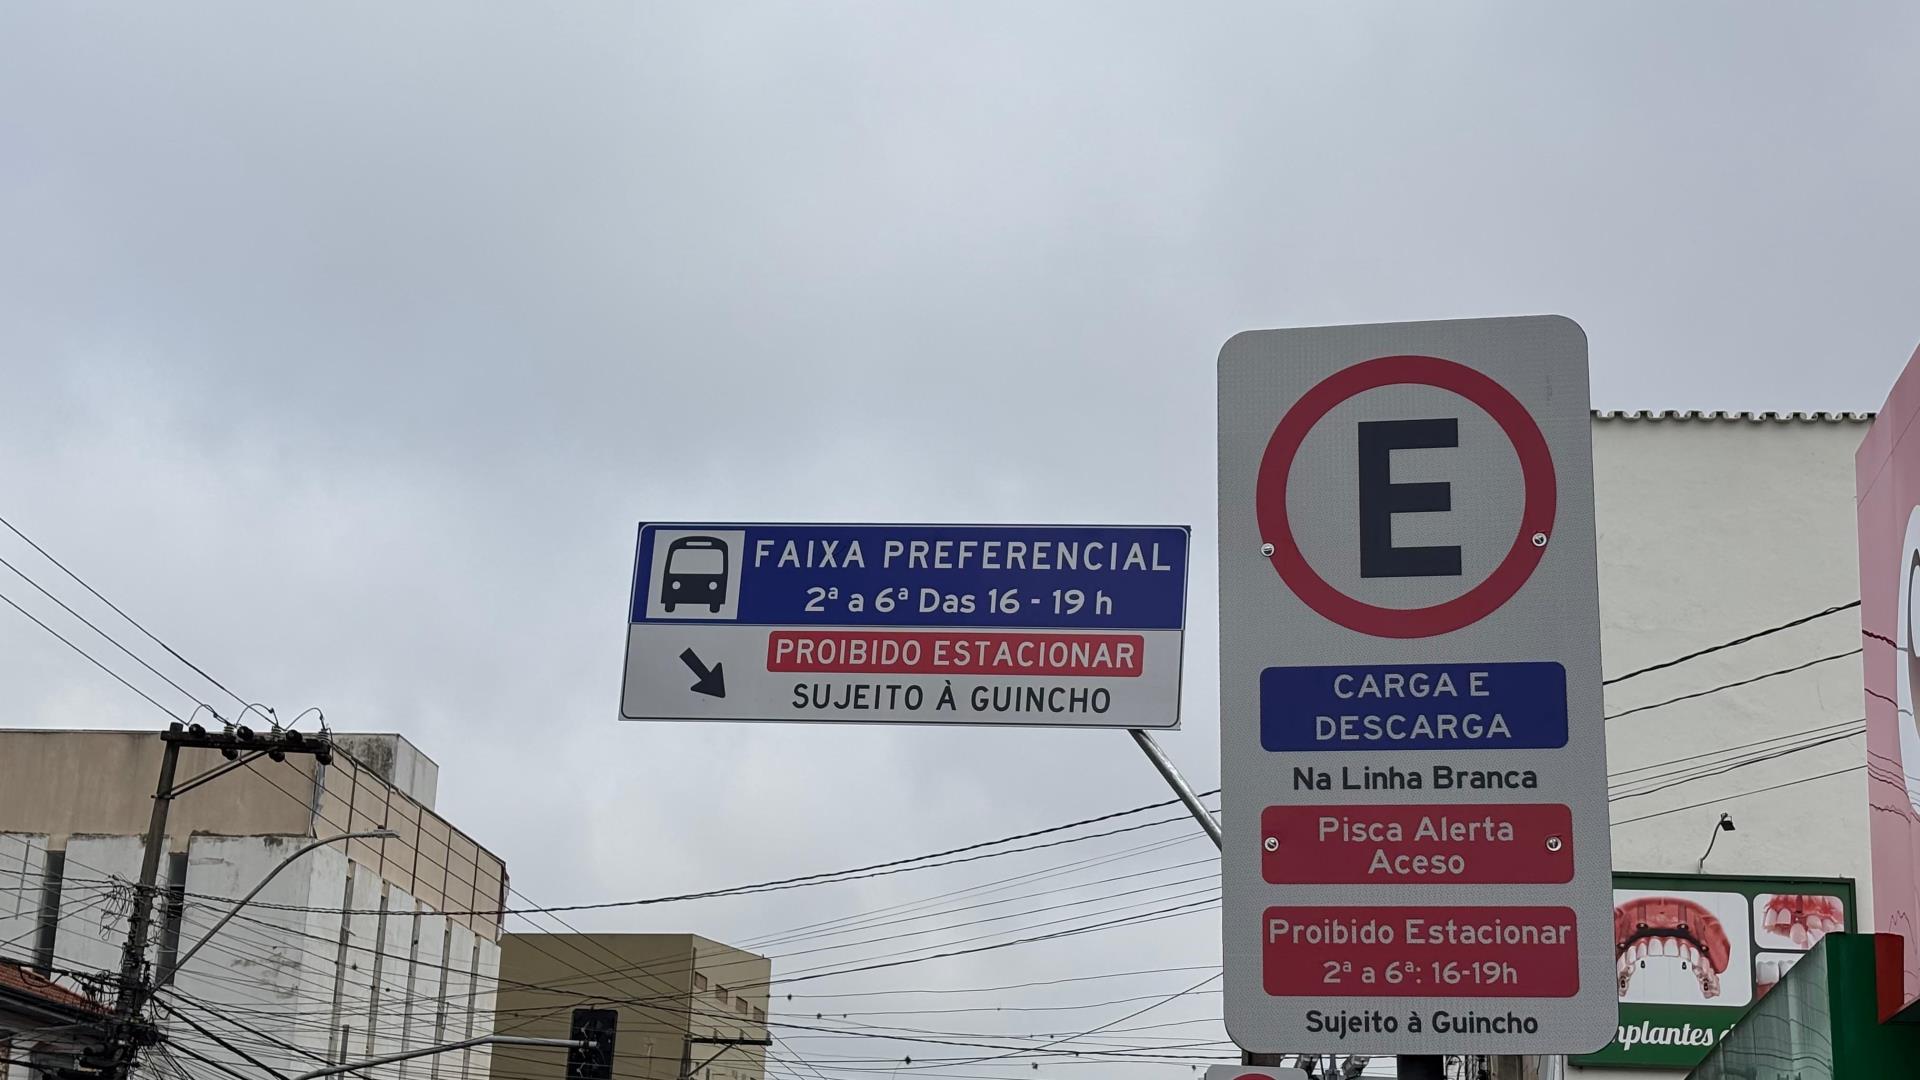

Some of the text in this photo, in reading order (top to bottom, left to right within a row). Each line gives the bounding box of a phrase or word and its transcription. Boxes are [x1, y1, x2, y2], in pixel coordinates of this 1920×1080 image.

[1358, 418, 1462, 578] E
[755, 540, 1171, 571] FAIXA PREFERENCIAL
[848, 593, 865, 612] a
[919, 588, 976, 613] Das
[988, 588, 1020, 614] 16
[1052, 589, 1085, 615] 19
[1095, 590, 1112, 615] h
[775, 638, 1135, 669] PROIBIDO ESTACIONAR
[792, 679, 1112, 714] SUJEITO À GUINCHO
[1333, 671, 1490, 699] CARGA E
[1315, 713, 1512, 742] DESCARGA
[1293, 765, 1538, 791] Na Linha Branca
[1318, 816, 1514, 842] Pisca Alerta
[1368, 848, 1465, 875] Aceso
[1268, 918, 1572, 945] Proibido Estacionar
[1361, 966, 1376, 984] a
[1431, 961, 1518, 985] 16-19h
[1305, 1009, 1539, 1040] Sujeito à Guincho
